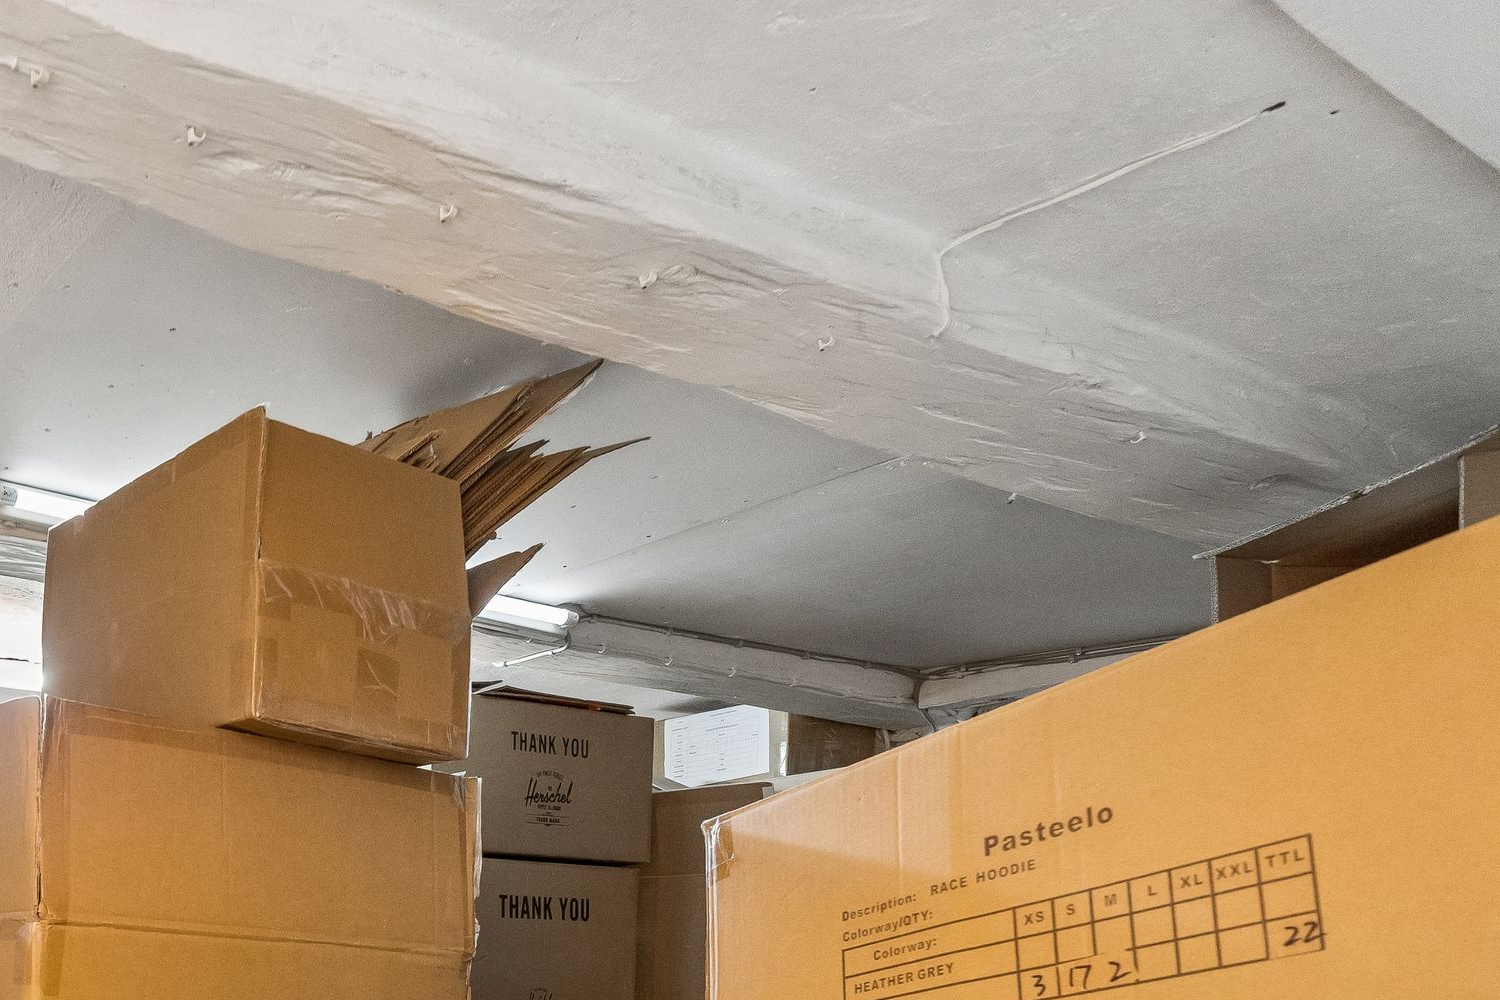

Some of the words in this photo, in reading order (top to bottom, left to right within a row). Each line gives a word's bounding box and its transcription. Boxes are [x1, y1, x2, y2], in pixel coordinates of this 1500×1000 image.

[511, 731, 556, 755] THANK
[562, 737, 589, 758] YOU
[525, 777, 573, 807] Herschel
[983, 806, 1114, 857] Pasteelo
[499, 894, 553, 921] THANK
[559, 897, 590, 922] YOU
[842, 894, 916, 922] Description:
[930, 877, 968, 896] RACE
[975, 858, 1037, 883] HOODIE
[873, 938, 937, 961] Colorway:
[1024, 910, 1045, 925] XS
[1066, 903, 1075, 916] S
[1104, 894, 1117, 906] M
[1148, 884, 1157, 897] L
[1180, 873, 1203, 889] XL
[1215, 861, 1253, 881] XXL
[1264, 849, 1306, 869] TTL
[854, 971, 914, 994] HEATHER
[918, 962, 954, 981] GREY
[1031, 973, 1046, 997] 3
[1069, 964, 1091, 989] 17
[1108, 961, 1132, 983] 2
[1283, 921, 1321, 946] 22
